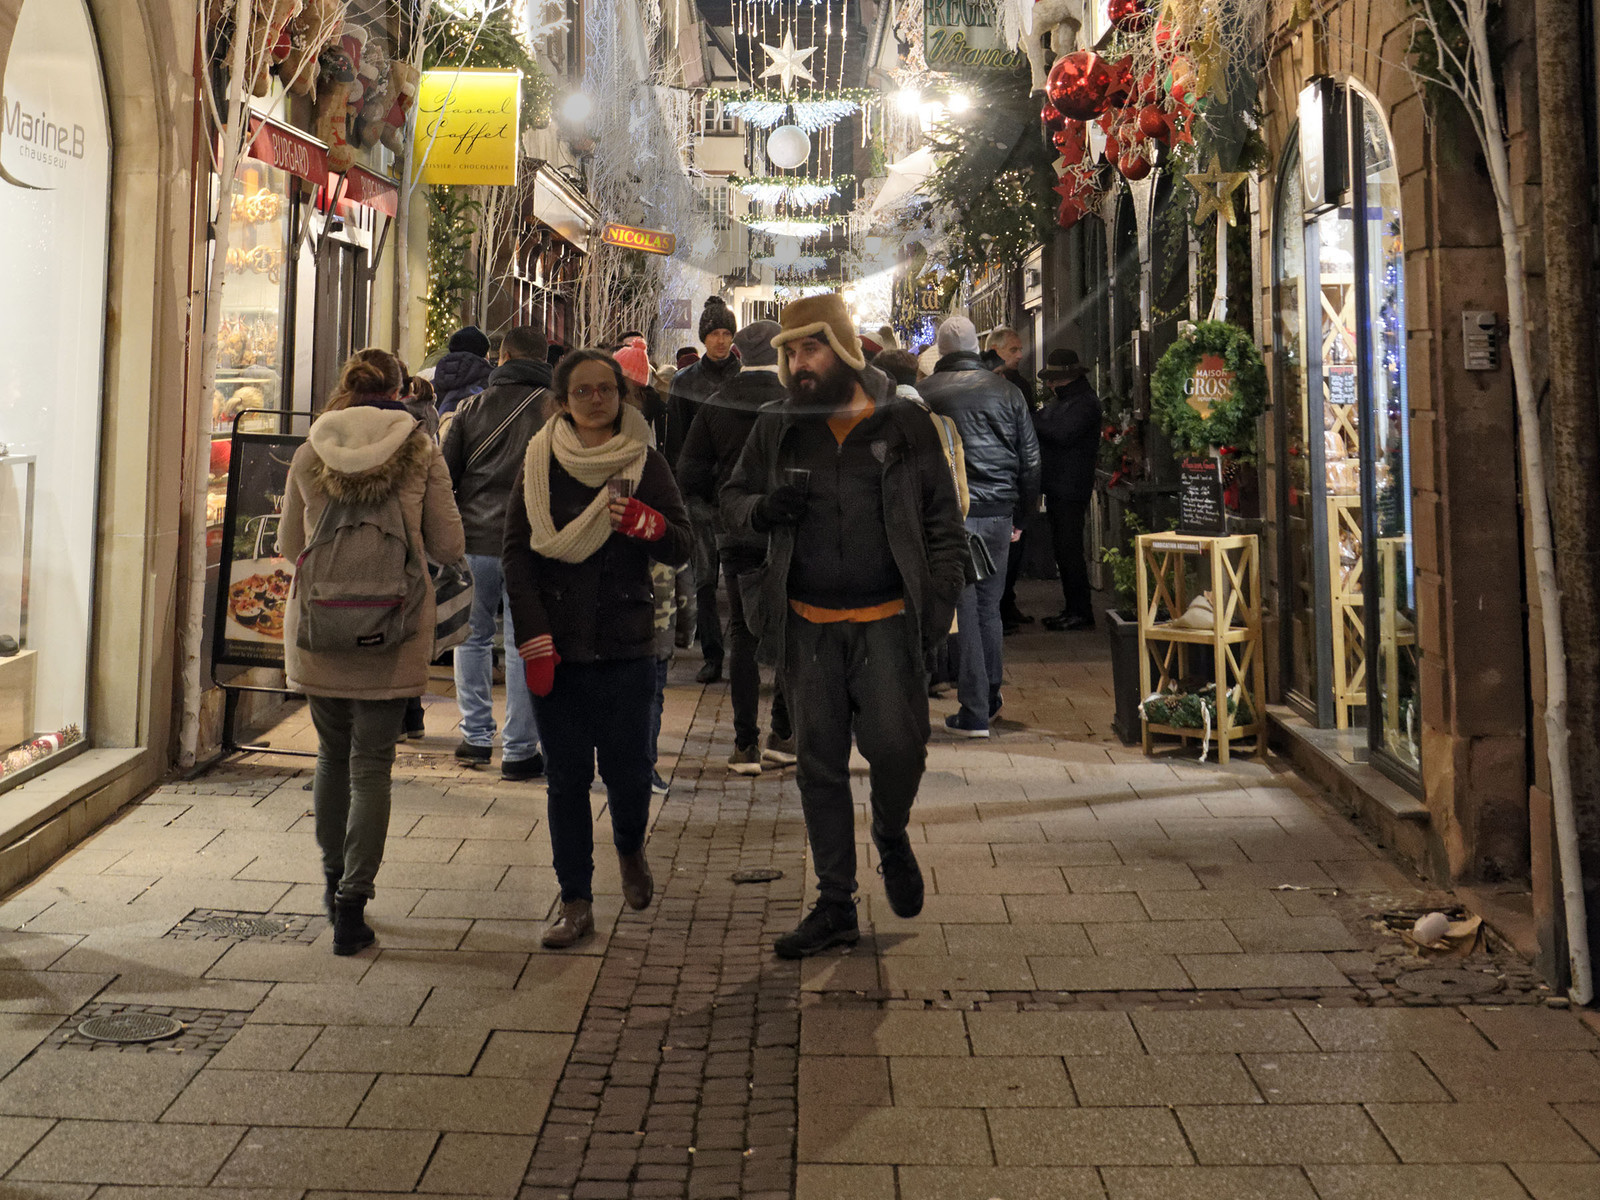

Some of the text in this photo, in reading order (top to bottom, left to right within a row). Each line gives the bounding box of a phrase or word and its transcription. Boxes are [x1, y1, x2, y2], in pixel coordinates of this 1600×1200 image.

[419, 92, 512, 115] Pascal
[3, 95, 85, 160] Marine.B
[420, 116, 509, 155] Caffet
[20, 144, 68, 169] chausseur
[272, 133, 310, 176] BURGARD
[607, 227, 670, 250] NICOLAS
[1196, 369, 1228, 377] MAISON
